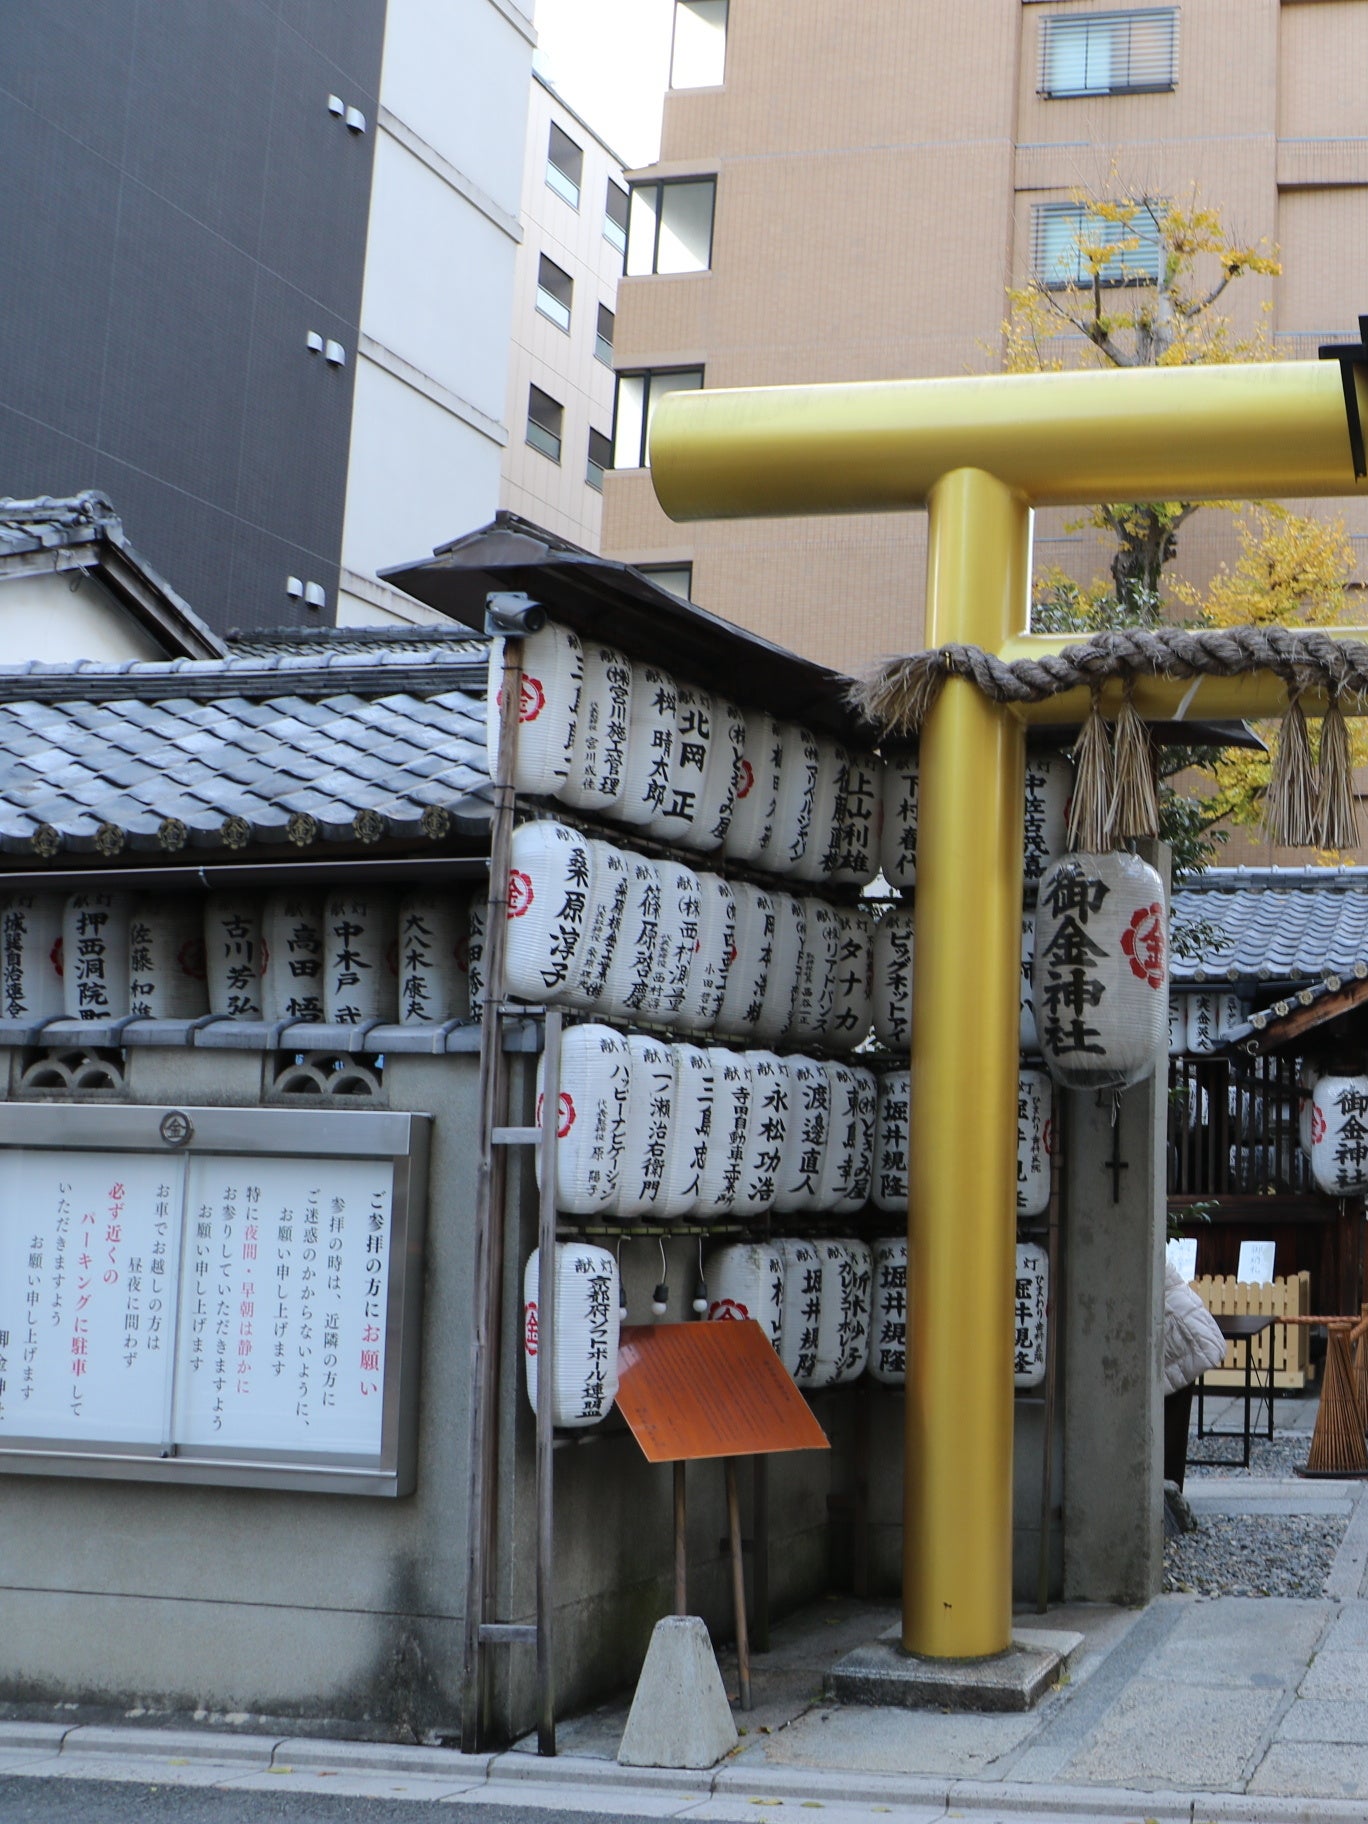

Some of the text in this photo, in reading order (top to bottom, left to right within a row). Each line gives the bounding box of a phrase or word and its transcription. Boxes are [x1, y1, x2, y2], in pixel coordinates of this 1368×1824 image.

[662, 710, 710, 822] 北岡正
[222, 914, 259, 1016] 古川芳弘
[286, 923, 324, 1022] 高田悟
[333, 921, 373, 1023] 中木戸武
[404, 914, 434, 1020] 大八木康夫
[540, 848, 589, 988] 桑原淳子
[1041, 861, 1111, 1056] 御金神社
[835, 937, 863, 1031] タナカ
[639, 1074, 673, 1202] 一ノ瀬治右衛門
[748, 1082, 788, 1202] 永松功浩
[880, 1099, 909, 1199] 堀井規隆
[51, 1183, 73, 1327] いただきますよう
[103, 1182, 126, 1284] 必ず近くの
[147, 1184, 170, 1350] お車でお越しの方は
[190, 1205, 212, 1372] お願い申し上げます
[272, 1208, 293, 1376] お願い申し上げます
[360, 1190, 387, 1396] ご参拝の方にお願い
[574, 1257, 614, 1275] 献灯
[21, 1235, 44, 1400] お願い申し上げます
[70, 1213, 95, 1416] パーキングに駐車して
[123, 1258, 143, 1368] 昼夜に問わず
[212, 1187, 237, 1431] お参りしていただきますよう
[296, 1189, 320, 1426] ご迷惑のかからないように、
[880, 1265, 907, 1373] 堀井規隆
